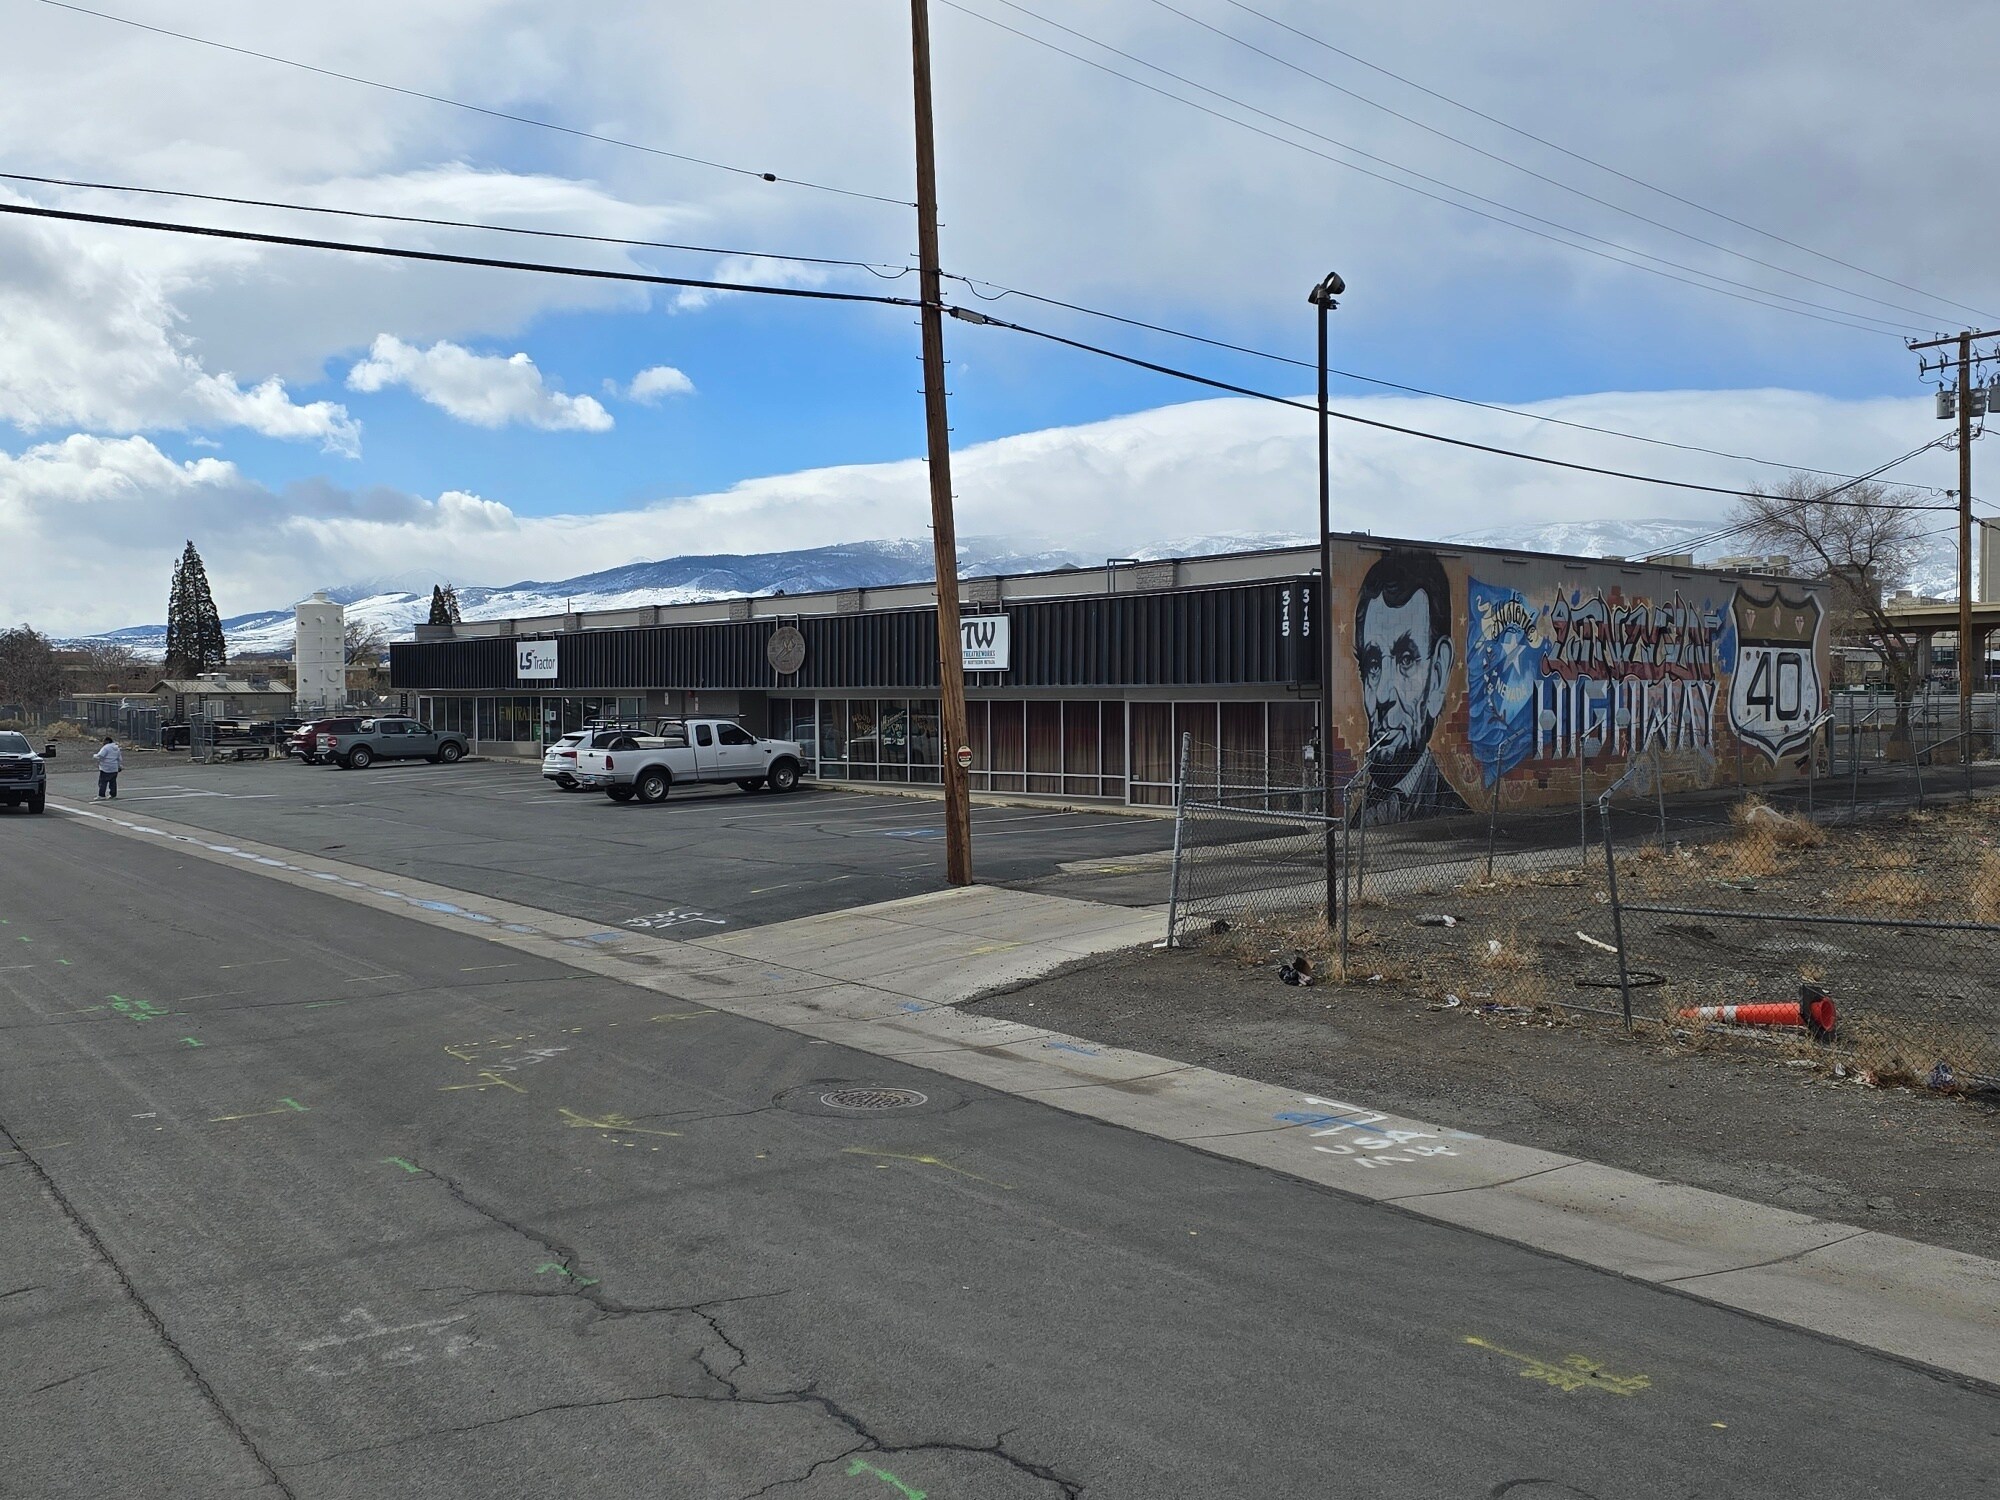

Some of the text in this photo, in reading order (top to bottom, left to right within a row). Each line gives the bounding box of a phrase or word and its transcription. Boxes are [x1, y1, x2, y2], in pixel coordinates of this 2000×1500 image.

[1282, 590, 1290, 636] 315
[961, 622, 995, 649] TW
[519, 651, 555, 670] LS Tractor
[1495, 678, 1528, 703] NEVADA
[1747, 652, 1802, 722] 40
[1532, 679, 1720, 759] HIGHWAY
